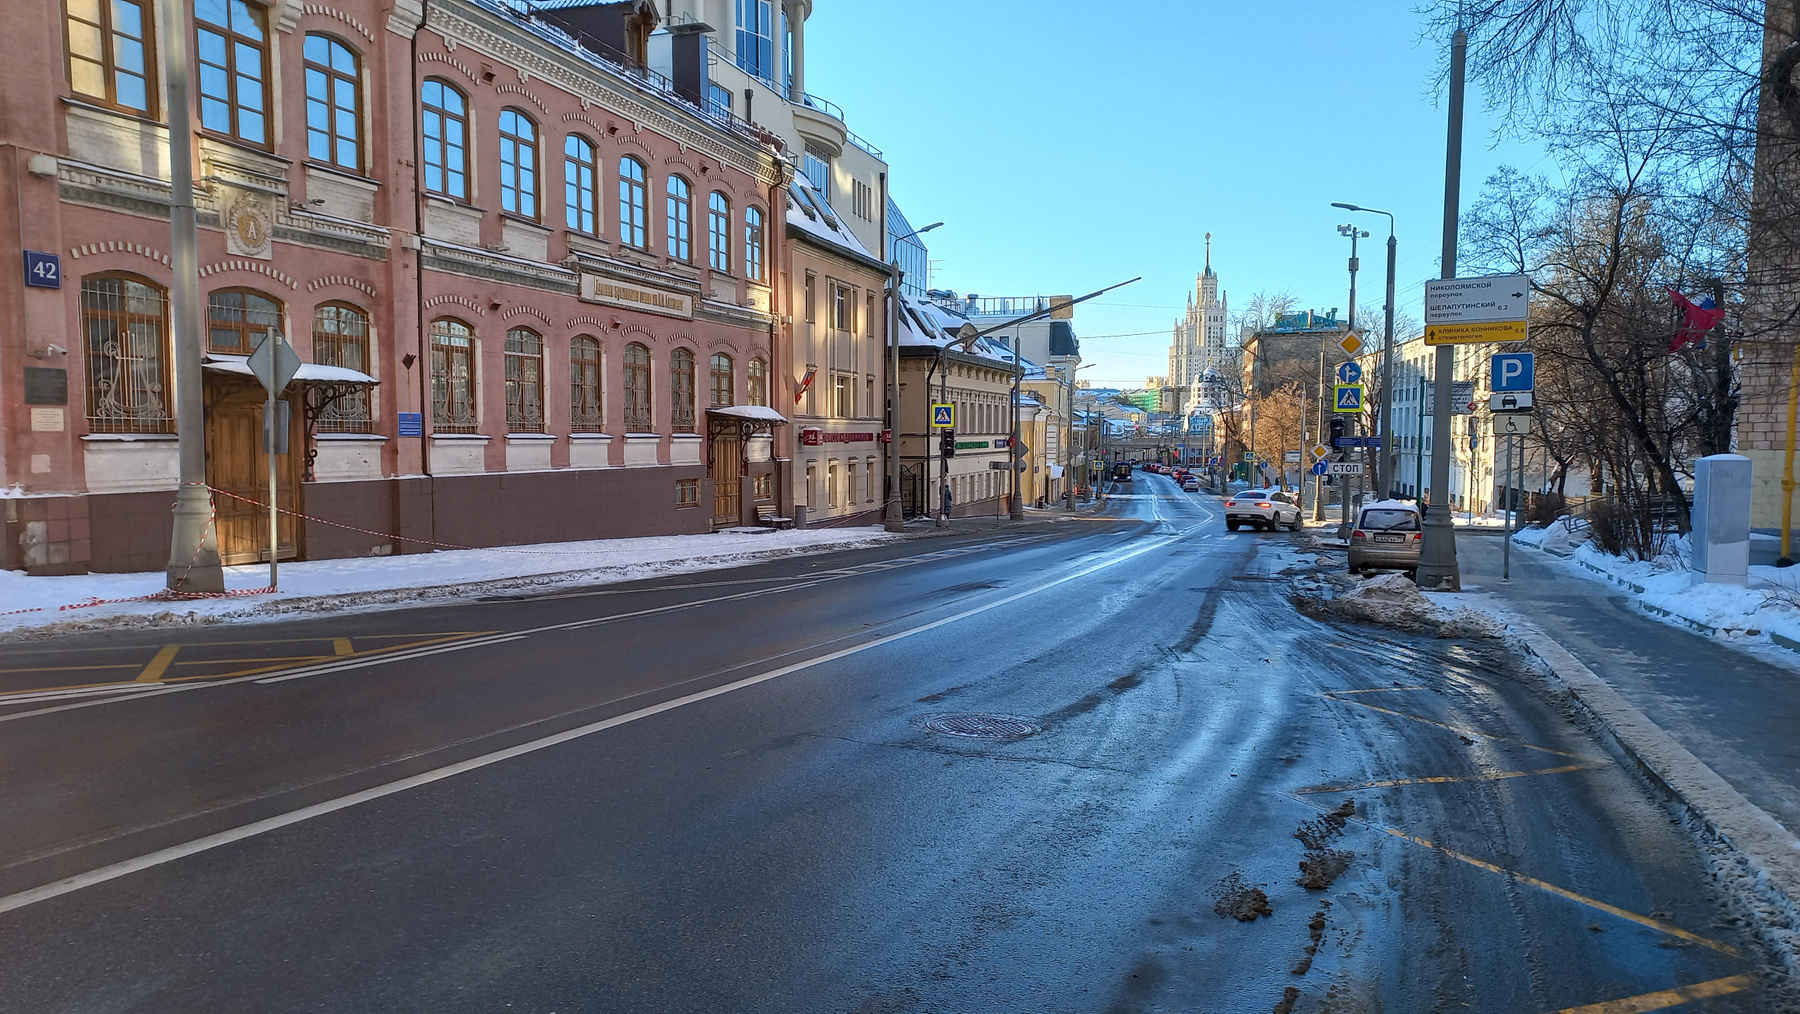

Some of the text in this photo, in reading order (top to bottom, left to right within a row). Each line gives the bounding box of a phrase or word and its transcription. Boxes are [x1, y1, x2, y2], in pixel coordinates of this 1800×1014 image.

[33, 261, 57, 280] 42
[1430, 282, 1492, 291] НИКОЛОЯМСКОЙ
[1430, 301, 1496, 311] ШЕЛАПУТИНСКИЙ
[1471, 325, 1513, 333] КОННИКОВА
[1501, 358, 1523, 387] P
[1332, 464, 1359, 473] СТОП
